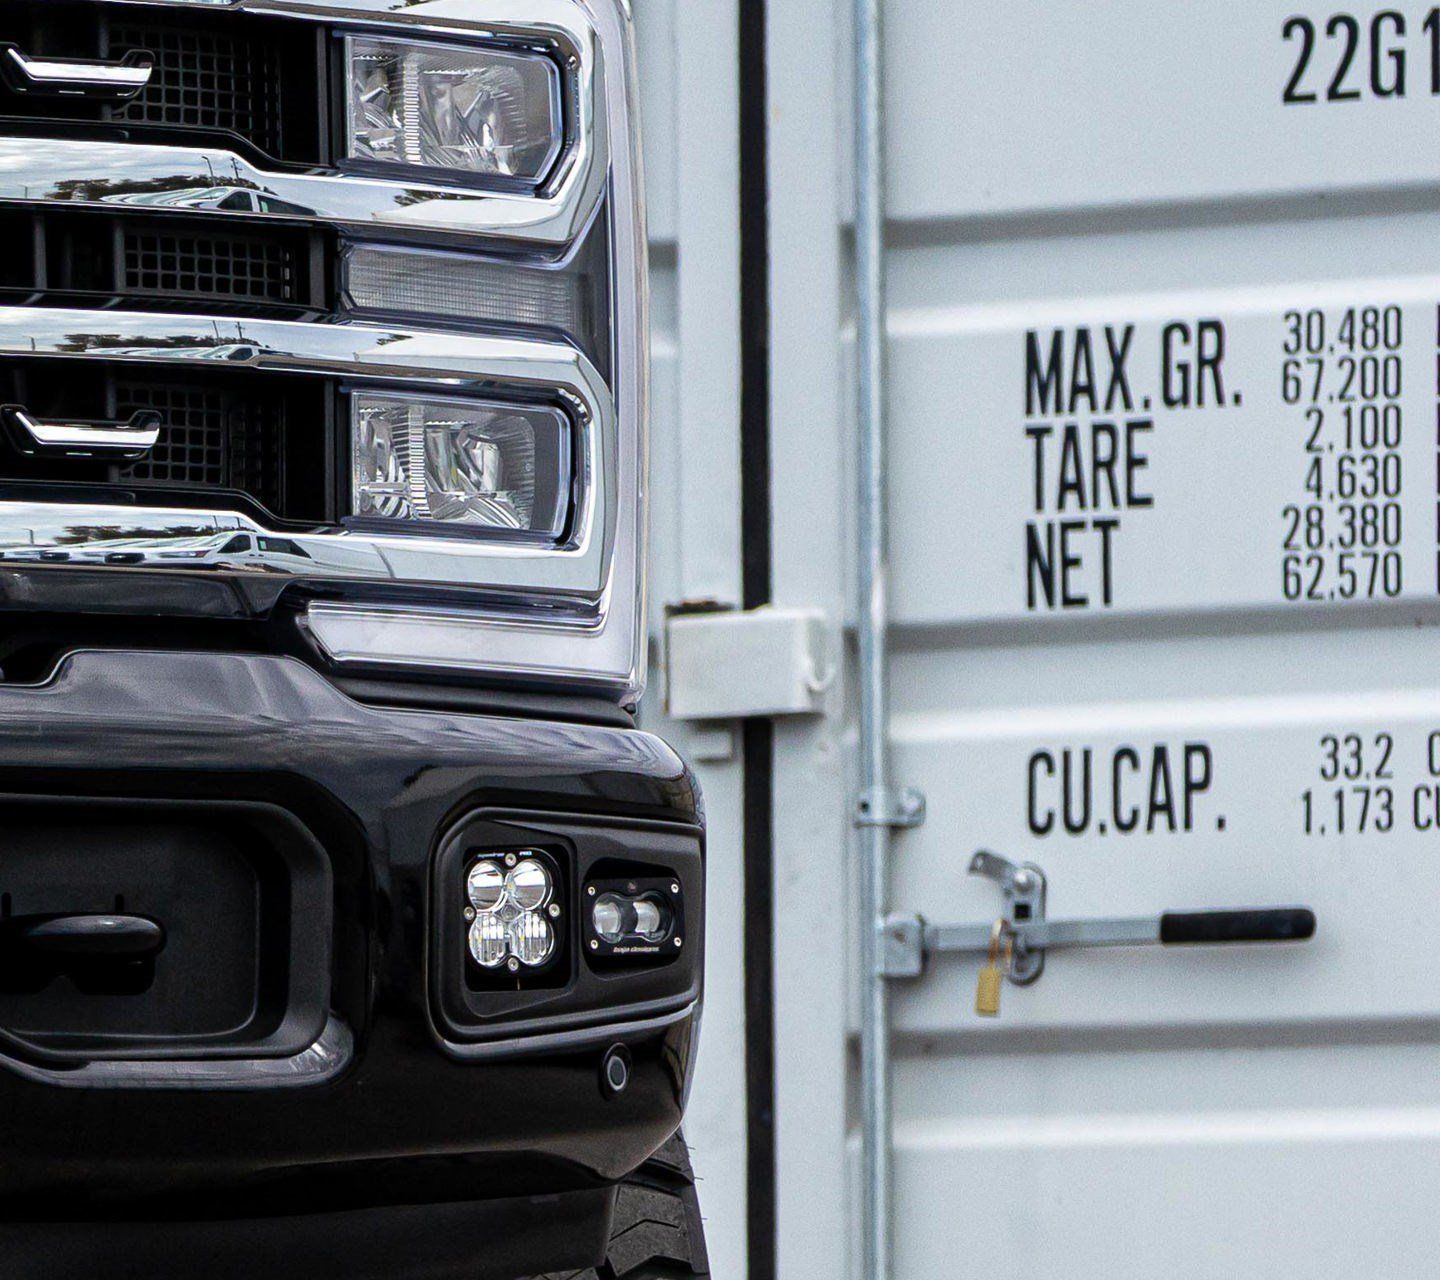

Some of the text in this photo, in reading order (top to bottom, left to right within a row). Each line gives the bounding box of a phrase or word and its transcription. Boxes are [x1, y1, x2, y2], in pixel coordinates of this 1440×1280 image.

[1282, 5, 1440, 106] 22G1
[1282, 304, 1403, 355] 30.480
[1025, 318, 1243, 418] MAX.GR.
[1282, 354, 1402, 405] 67.200
[1304, 403, 1402, 454] 2.100
[1025, 419, 1156, 512] TARE
[1305, 453, 1403, 502] 4.630
[1282, 502, 1403, 551] 28.380
[1026, 517, 1121, 610] NET
[1283, 551, 1403, 601] 62.570
[1319, 733, 1394, 781] 33.2
[1027, 733, 1228, 839] CU.CAP.
[1302, 785, 1394, 837] 1.173
